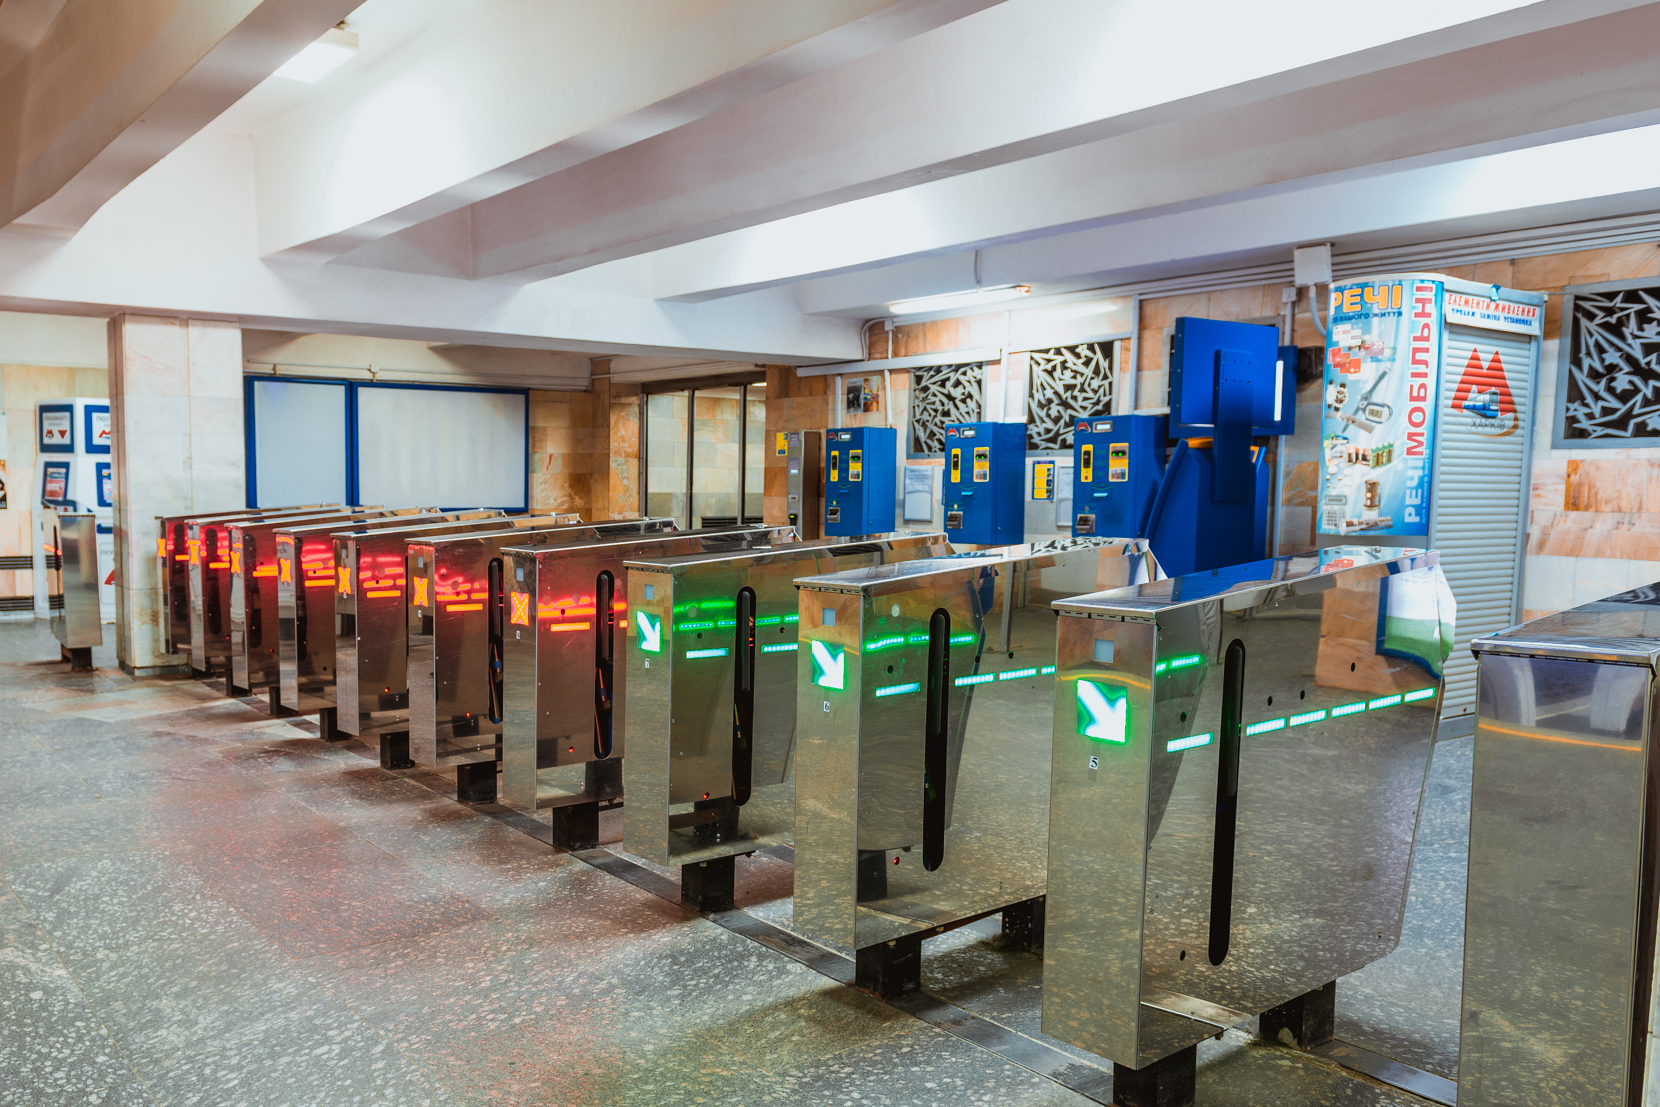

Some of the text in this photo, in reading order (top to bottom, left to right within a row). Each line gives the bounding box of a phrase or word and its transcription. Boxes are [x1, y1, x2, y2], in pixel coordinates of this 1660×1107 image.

[1330, 285, 1402, 315] РЕЧІ
[1405, 285, 1434, 456] МОБІЛЬНІ
[1404, 459, 1424, 523] РЕЧІ
[1091, 757, 1098, 769] 5
